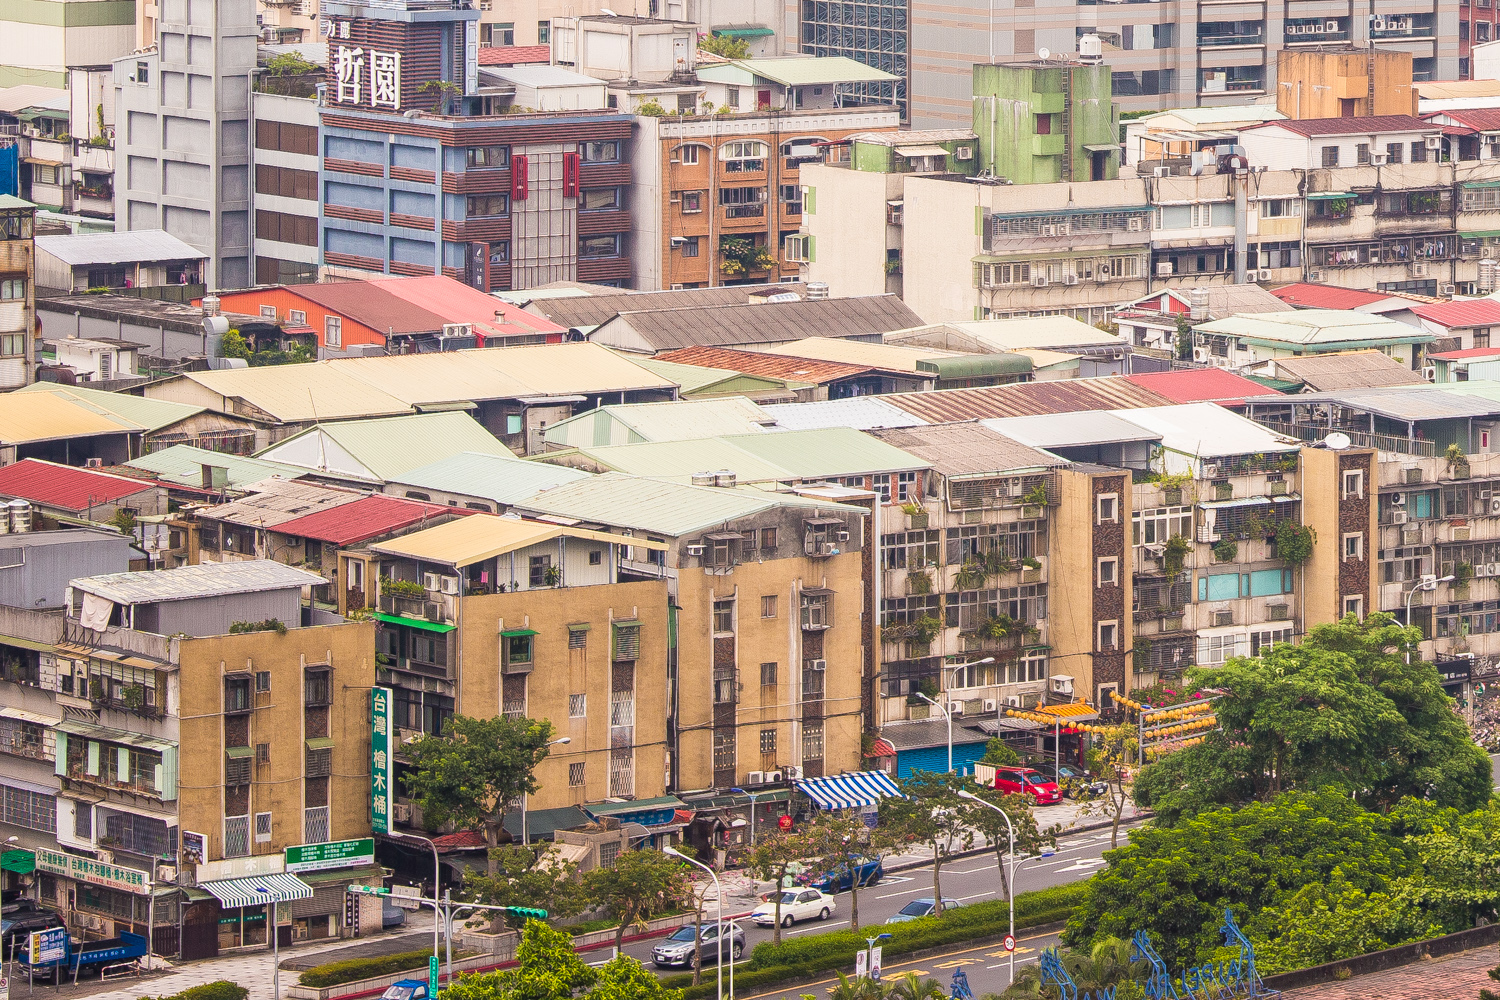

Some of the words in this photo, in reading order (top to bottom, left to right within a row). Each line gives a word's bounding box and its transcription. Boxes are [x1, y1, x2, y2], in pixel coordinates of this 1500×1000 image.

[333, 45, 401, 110] 哲園
[373, 749, 387, 815] 檜木桶
